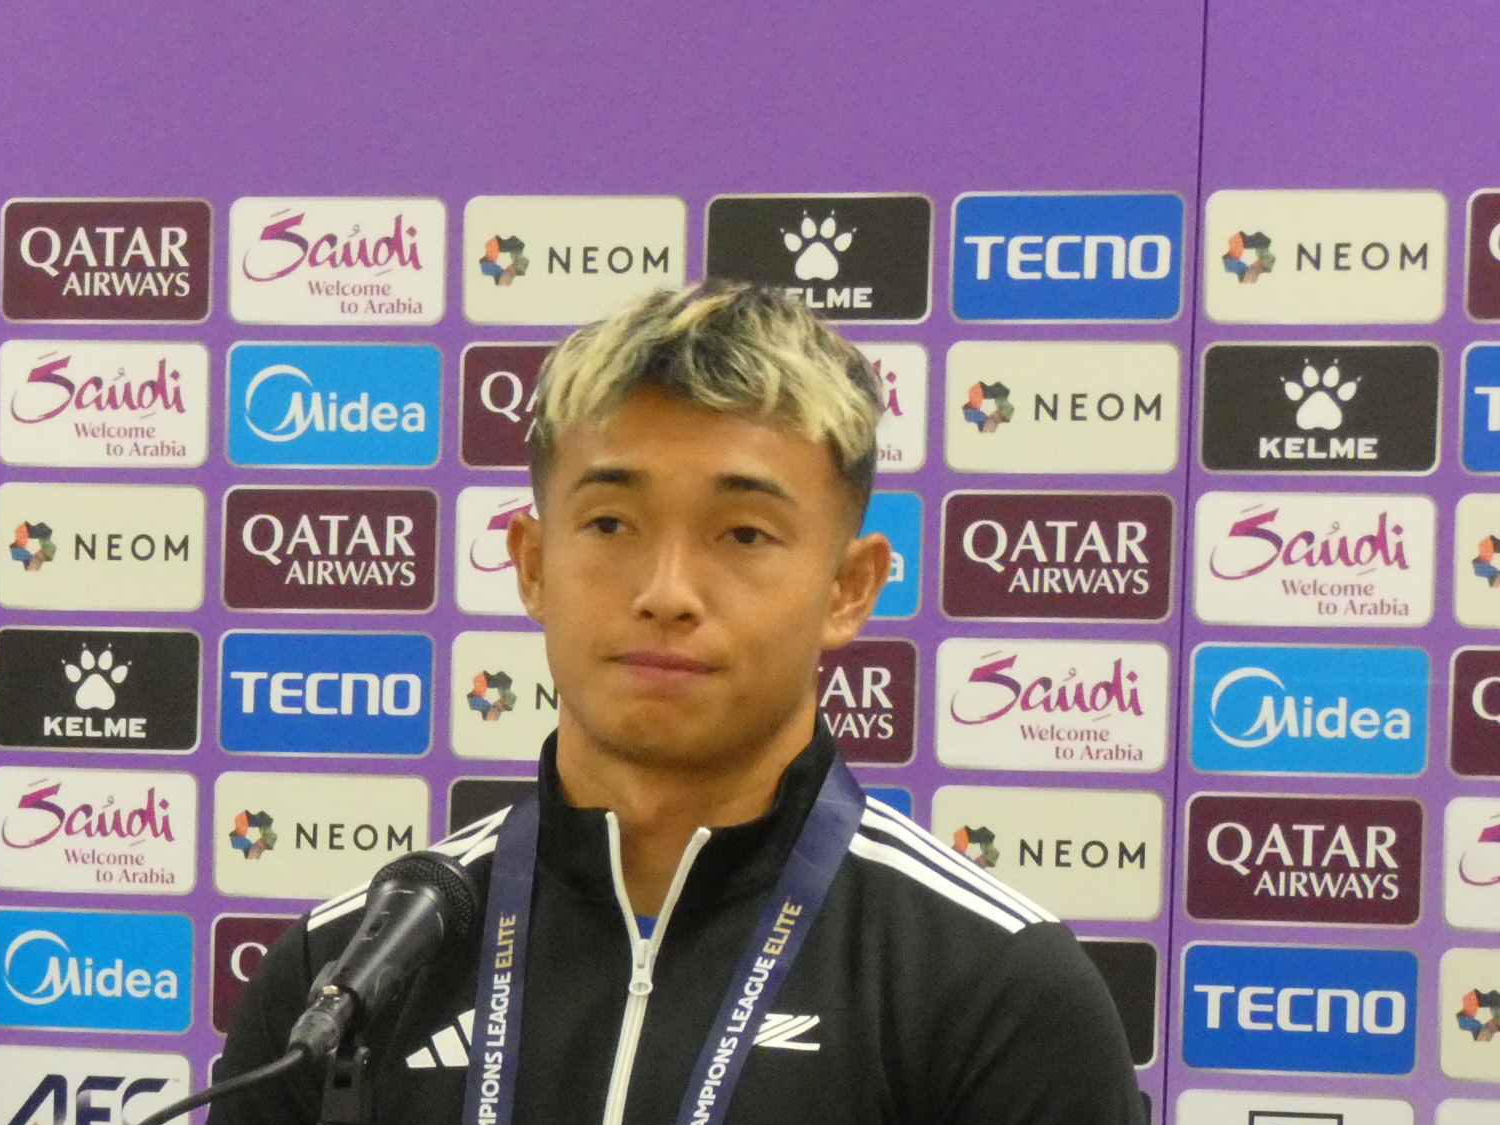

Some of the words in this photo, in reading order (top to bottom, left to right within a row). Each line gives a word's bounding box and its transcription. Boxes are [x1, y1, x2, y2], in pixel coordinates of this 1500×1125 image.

[20, 227, 189, 277] QATAR
[243, 214, 422, 282] Saudi
[548, 246, 669, 273] NEOM
[964, 235, 1171, 280] TECNO
[1297, 242, 1428, 270] NEOM
[63, 272, 190, 296] AIRWAYS
[308, 280, 391, 296] Welcome
[341, 301, 358, 313] to
[363, 298, 422, 314] Arabia
[11, 356, 185, 423] Saudi
[246, 365, 425, 442] Midea
[1035, 393, 1161, 421] NEOM
[74, 423, 155, 438] Welcome
[106, 443, 124, 456] to
[129, 441, 186, 457] Arabia
[1259, 437, 1378, 459] KELME
[75, 534, 188, 561] NEOM
[243, 514, 415, 565] QATAR
[963, 520, 1148, 572] QATAR
[1210, 509, 1408, 580] Saudi
[285, 561, 415, 586] AIRWAYS
[1009, 568, 1149, 594] AIRWAYS
[1282, 579, 1374, 596] Welcome
[1318, 601, 1338, 614] to
[1344, 599, 1408, 616] Arabia
[230, 672, 421, 716] TECNO
[951, 656, 1143, 725] Saudi
[1211, 667, 1410, 748] Midea
[44, 716, 146, 738] KELME
[1020, 725, 1108, 742] Welcome
[1055, 746, 1074, 759] to
[1080, 744, 1143, 761] Arabia
[2, 784, 174, 849] Saudi
[296, 823, 413, 851] NEOM
[1207, 822, 1398, 875] QATAR
[64, 849, 142, 866] Welcome
[1020, 839, 1145, 869] NEOM
[96, 869, 113, 882] to
[118, 868, 174, 884] Arabia
[1254, 871, 1399, 899] AIRWAYS
[495, 914, 516, 969] ELITE
[5, 930, 177, 1005] Midea
[727, 956, 775, 1033] LEAGUE
[763, 902, 802, 955] ELITE
[486, 972, 511, 1047] LEAGUE
[1194, 985, 1406, 1034] TECNO
